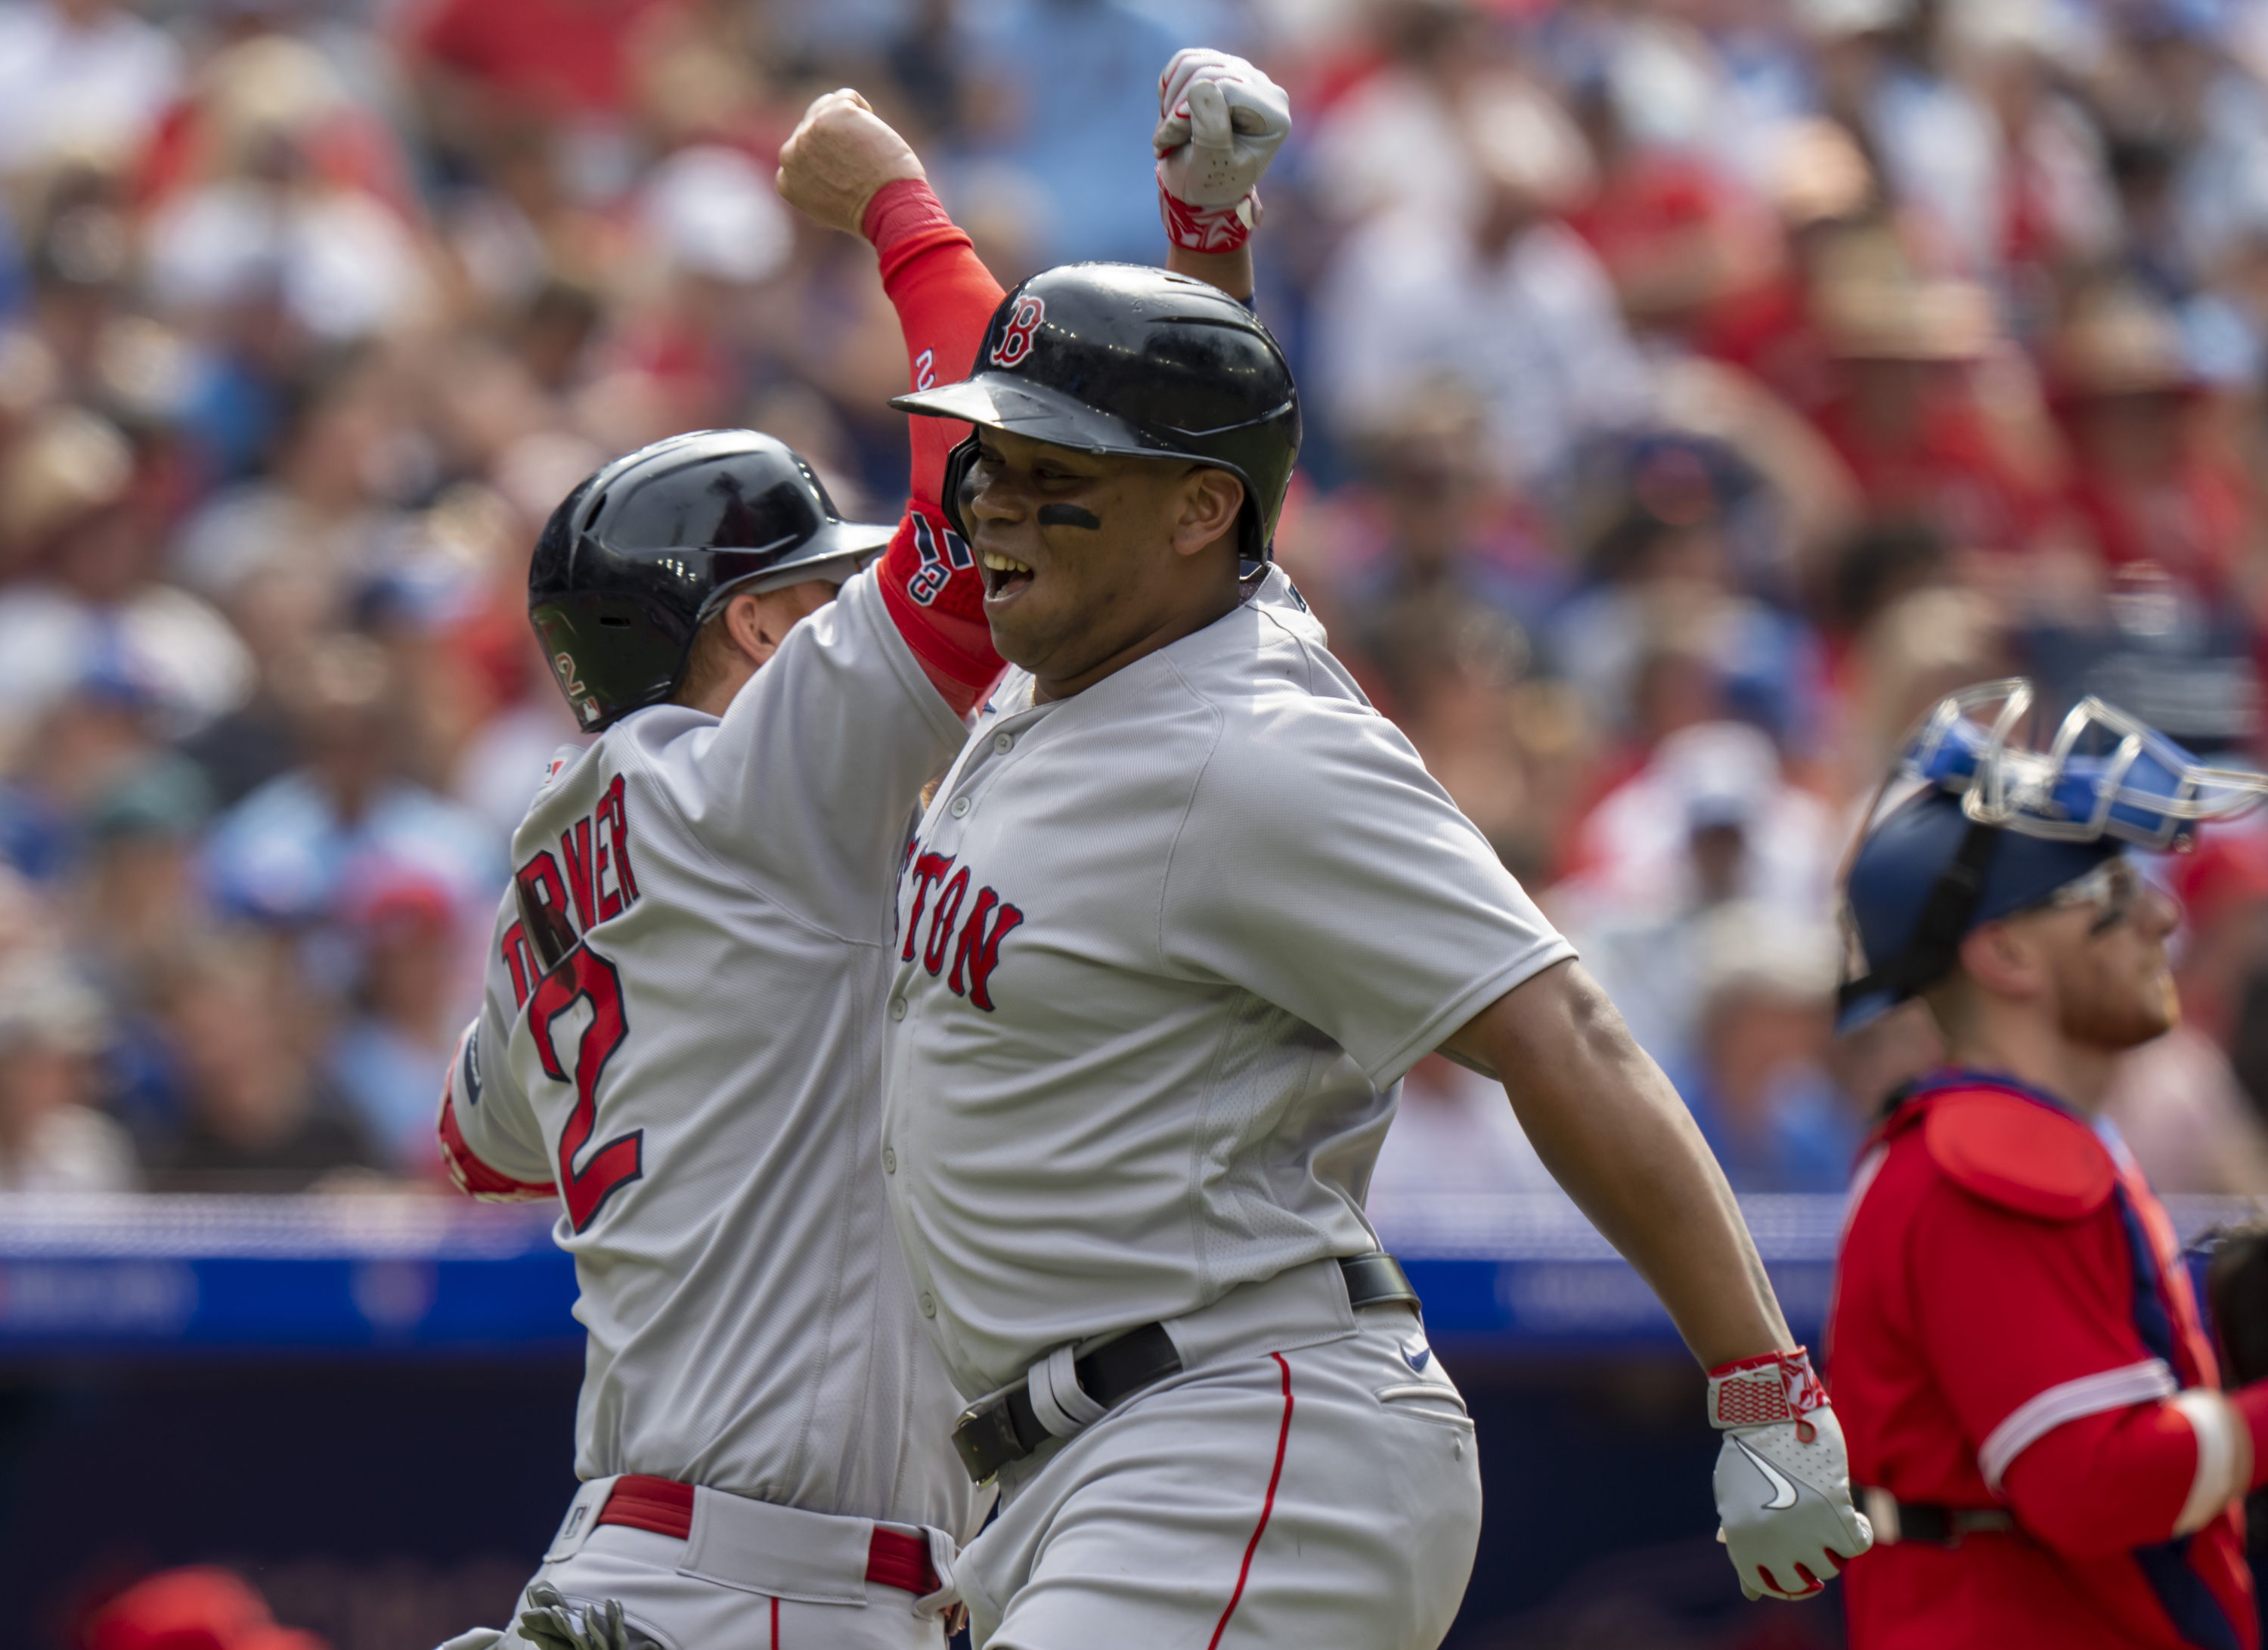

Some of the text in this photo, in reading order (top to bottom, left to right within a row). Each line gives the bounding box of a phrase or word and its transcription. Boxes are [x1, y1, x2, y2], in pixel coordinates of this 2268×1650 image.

[990, 294, 1046, 368] B
[916, 347, 935, 392] 2
[555, 652, 586, 696] 2
[894, 833, 1024, 1012] TON
[528, 938, 644, 1236] 2
